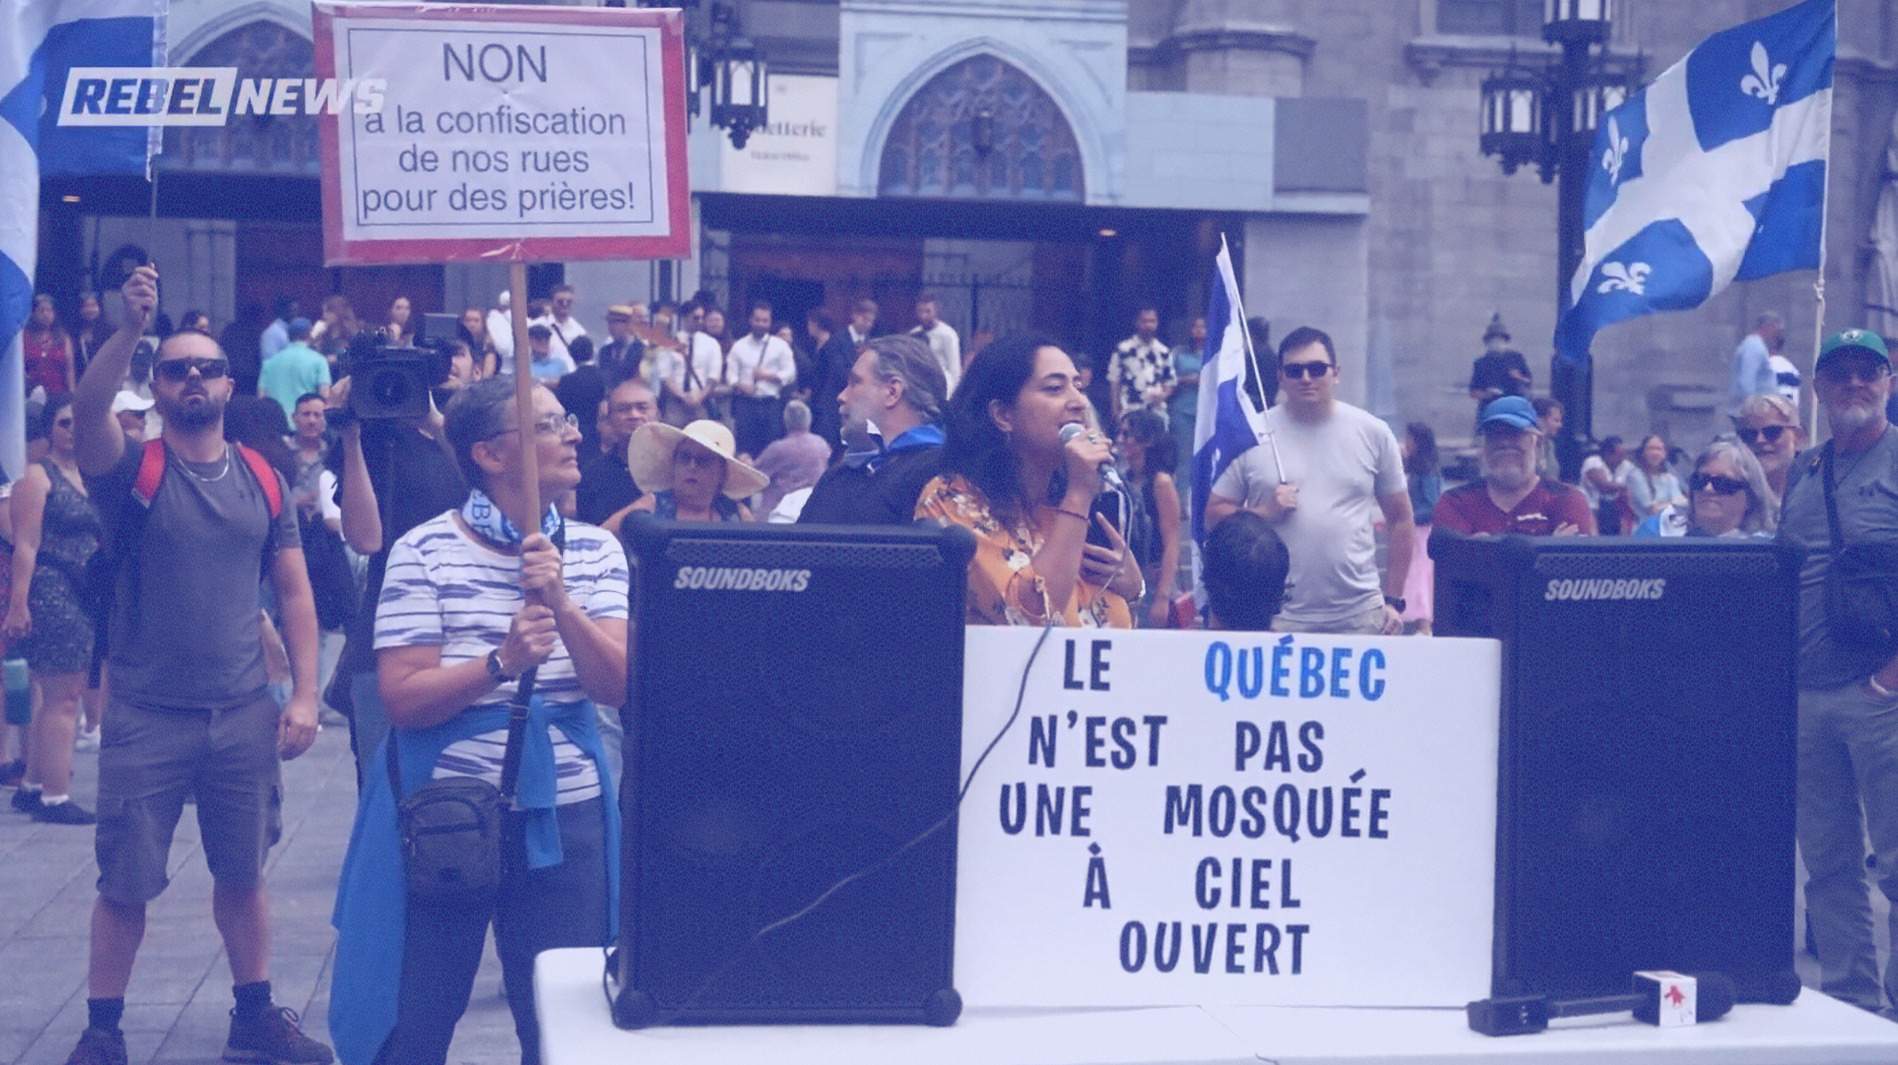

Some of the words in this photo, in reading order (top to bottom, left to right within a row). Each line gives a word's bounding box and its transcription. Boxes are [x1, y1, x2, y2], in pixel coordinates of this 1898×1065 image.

[443, 42, 548, 83] NON
[397, 105, 425, 134] la
[436, 105, 627, 136] confiscation
[398, 144, 439, 173] de
[451, 149, 510, 173] nos
[521, 149, 589, 173] rues
[362, 187, 438, 219] pour
[448, 182, 507, 211] des
[518, 182, 635, 218] prières!
[674, 566, 812, 592] SOUNDBOKS
[1544, 578, 1667, 601] SOUNDBOKS
[1063, 639, 1112, 692] LE
[1204, 635, 1387, 702] QUÉBEC
[1028, 710, 1169, 771] N'EST
[1234, 720, 1326, 774] PAS
[1000, 782, 1093, 837] UNE
[1163, 768, 1392, 843] MOSQUÉE
[1082, 842, 1112, 910] À
[1194, 856, 1302, 911] CIEL
[1119, 920, 1311, 976] OUVERT
